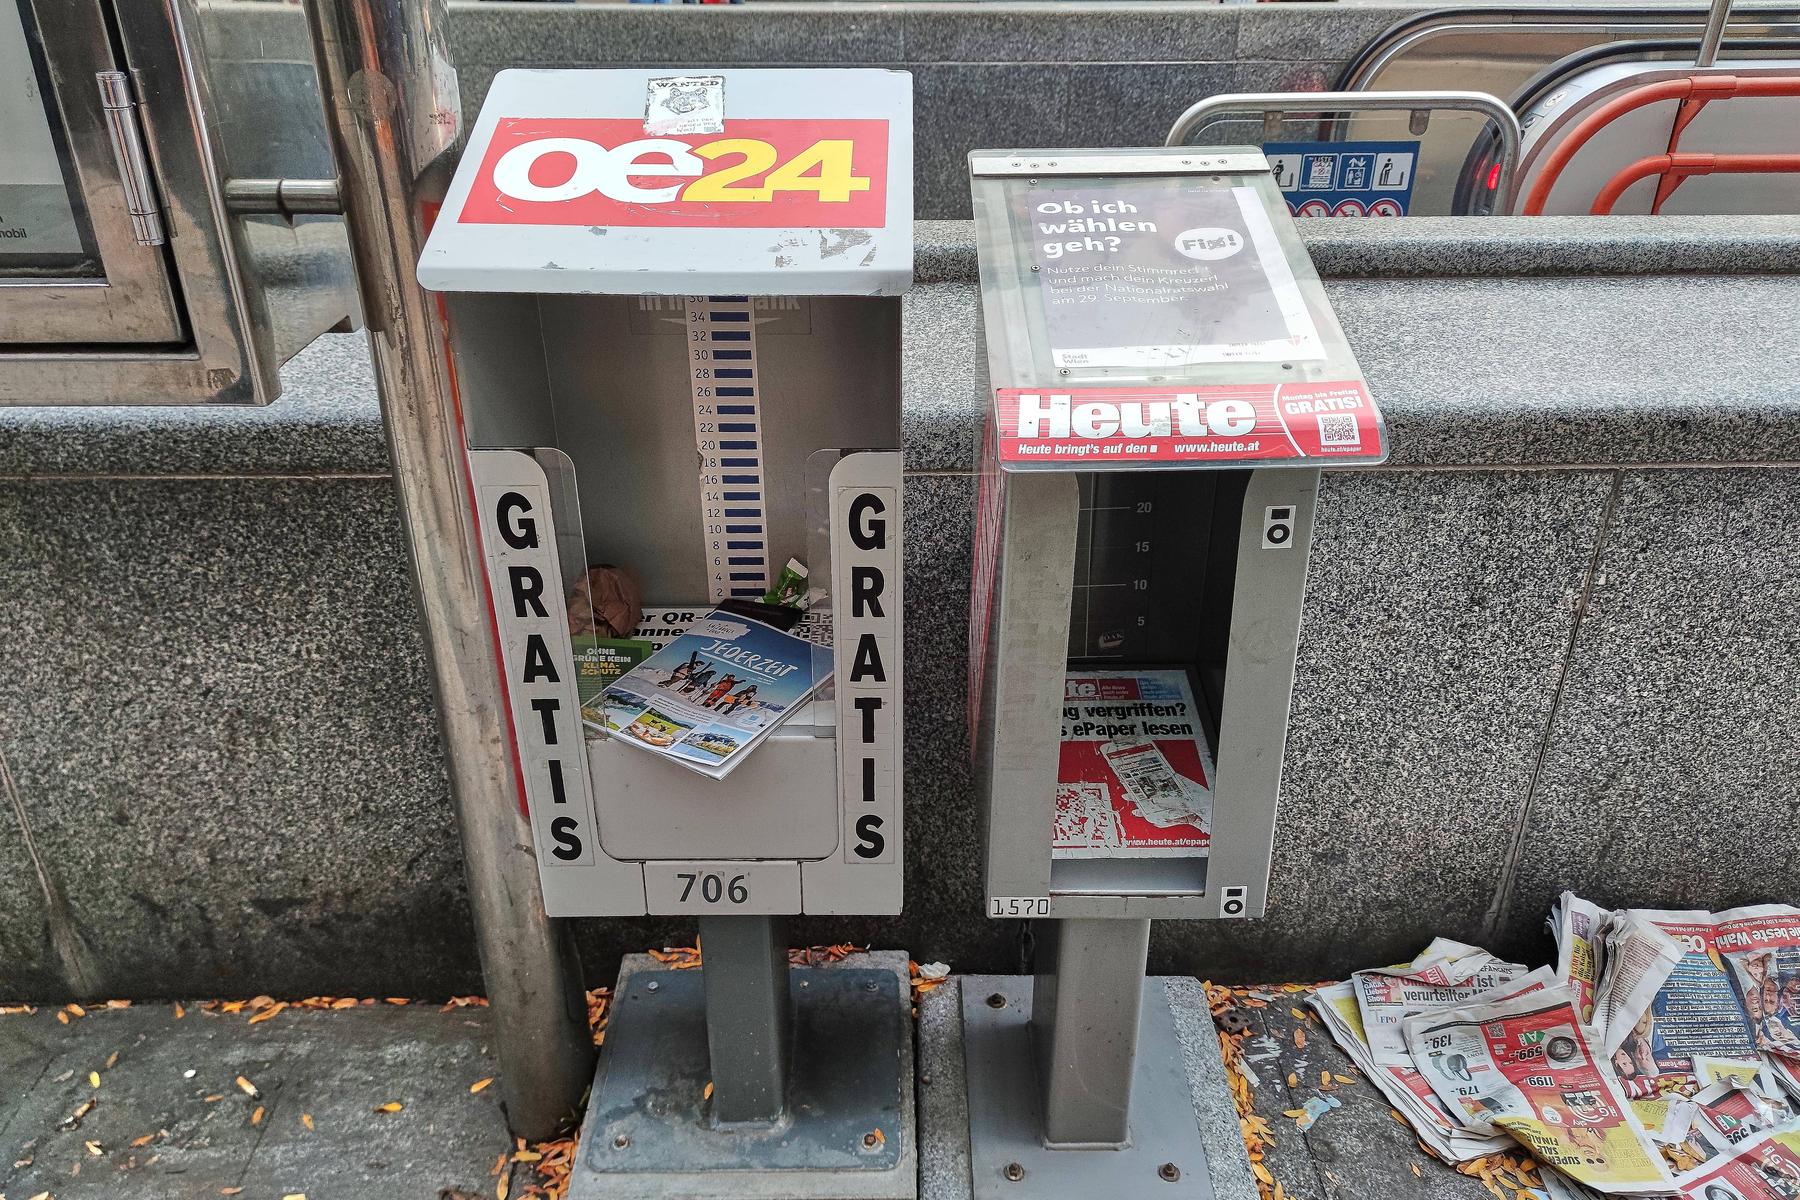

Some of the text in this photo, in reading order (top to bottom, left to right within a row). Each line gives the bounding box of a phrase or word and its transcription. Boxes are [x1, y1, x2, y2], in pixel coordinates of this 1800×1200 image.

[656, 80, 720, 88] WANTED
[492, 138, 871, 204] oe24
[1036, 200, 1138, 214] Ob ich
[1040, 218, 1157, 235] wählen
[1043, 236, 1122, 259] geh?
[1047, 265, 1090, 275] Nutze
[1094, 264, 1125, 272] dein
[1049, 273, 1218, 286] und mach dein Kreuzerl
[1051, 283, 1229, 295] bei der Nationalratswahl
[1052, 296, 1075, 305] am
[691, 312, 706, 322] 34
[692, 331, 707, 342] 32
[694, 350, 709, 360] 30
[695, 368, 710, 379] 28
[697, 387, 711, 397] 26
[1330, 389, 1358, 398] Freitag
[698, 405, 712, 415] 24
[1285, 396, 1363, 415] GRATIS!
[1018, 393, 1257, 439] Heute
[700, 423, 714, 433] 22
[701, 441, 716, 450] 20
[1018, 443, 1148, 456] Heute bringt's auf den
[1174, 441, 1260, 453] www.heute.at
[704, 458, 717, 468] 18
[705, 475, 718, 485] 16
[706, 492, 719, 502] 14
[707, 508, 720, 518] 12
[1136, 502, 1152, 514] 20
[708, 524, 722, 534] 10
[712, 541, 720, 550] 8
[1135, 542, 1150, 553] 15
[714, 557, 721, 566] 6
[715, 573, 722, 581] 4
[1133, 579, 1148, 590] 10
[717, 588, 723, 597] 2
[1137, 616, 1145, 627] 5
[587, 648, 616, 656] OHNE
[496, 491, 583, 862] GRATIS
[848, 492, 886, 859] GRATIS
[1084, 703, 1187, 721] vergriffen?
[1073, 722, 1137, 739] ePaper
[1141, 722, 1193, 736] lesen
[676, 873, 749, 904] 706
[992, 898, 1050, 916] 1570
[1715, 931, 1752, 950] Wahl
[1752, 928, 1790, 942] beste
[1477, 975, 1494, 987] ist
[1404, 989, 1470, 1002] verurteilter
